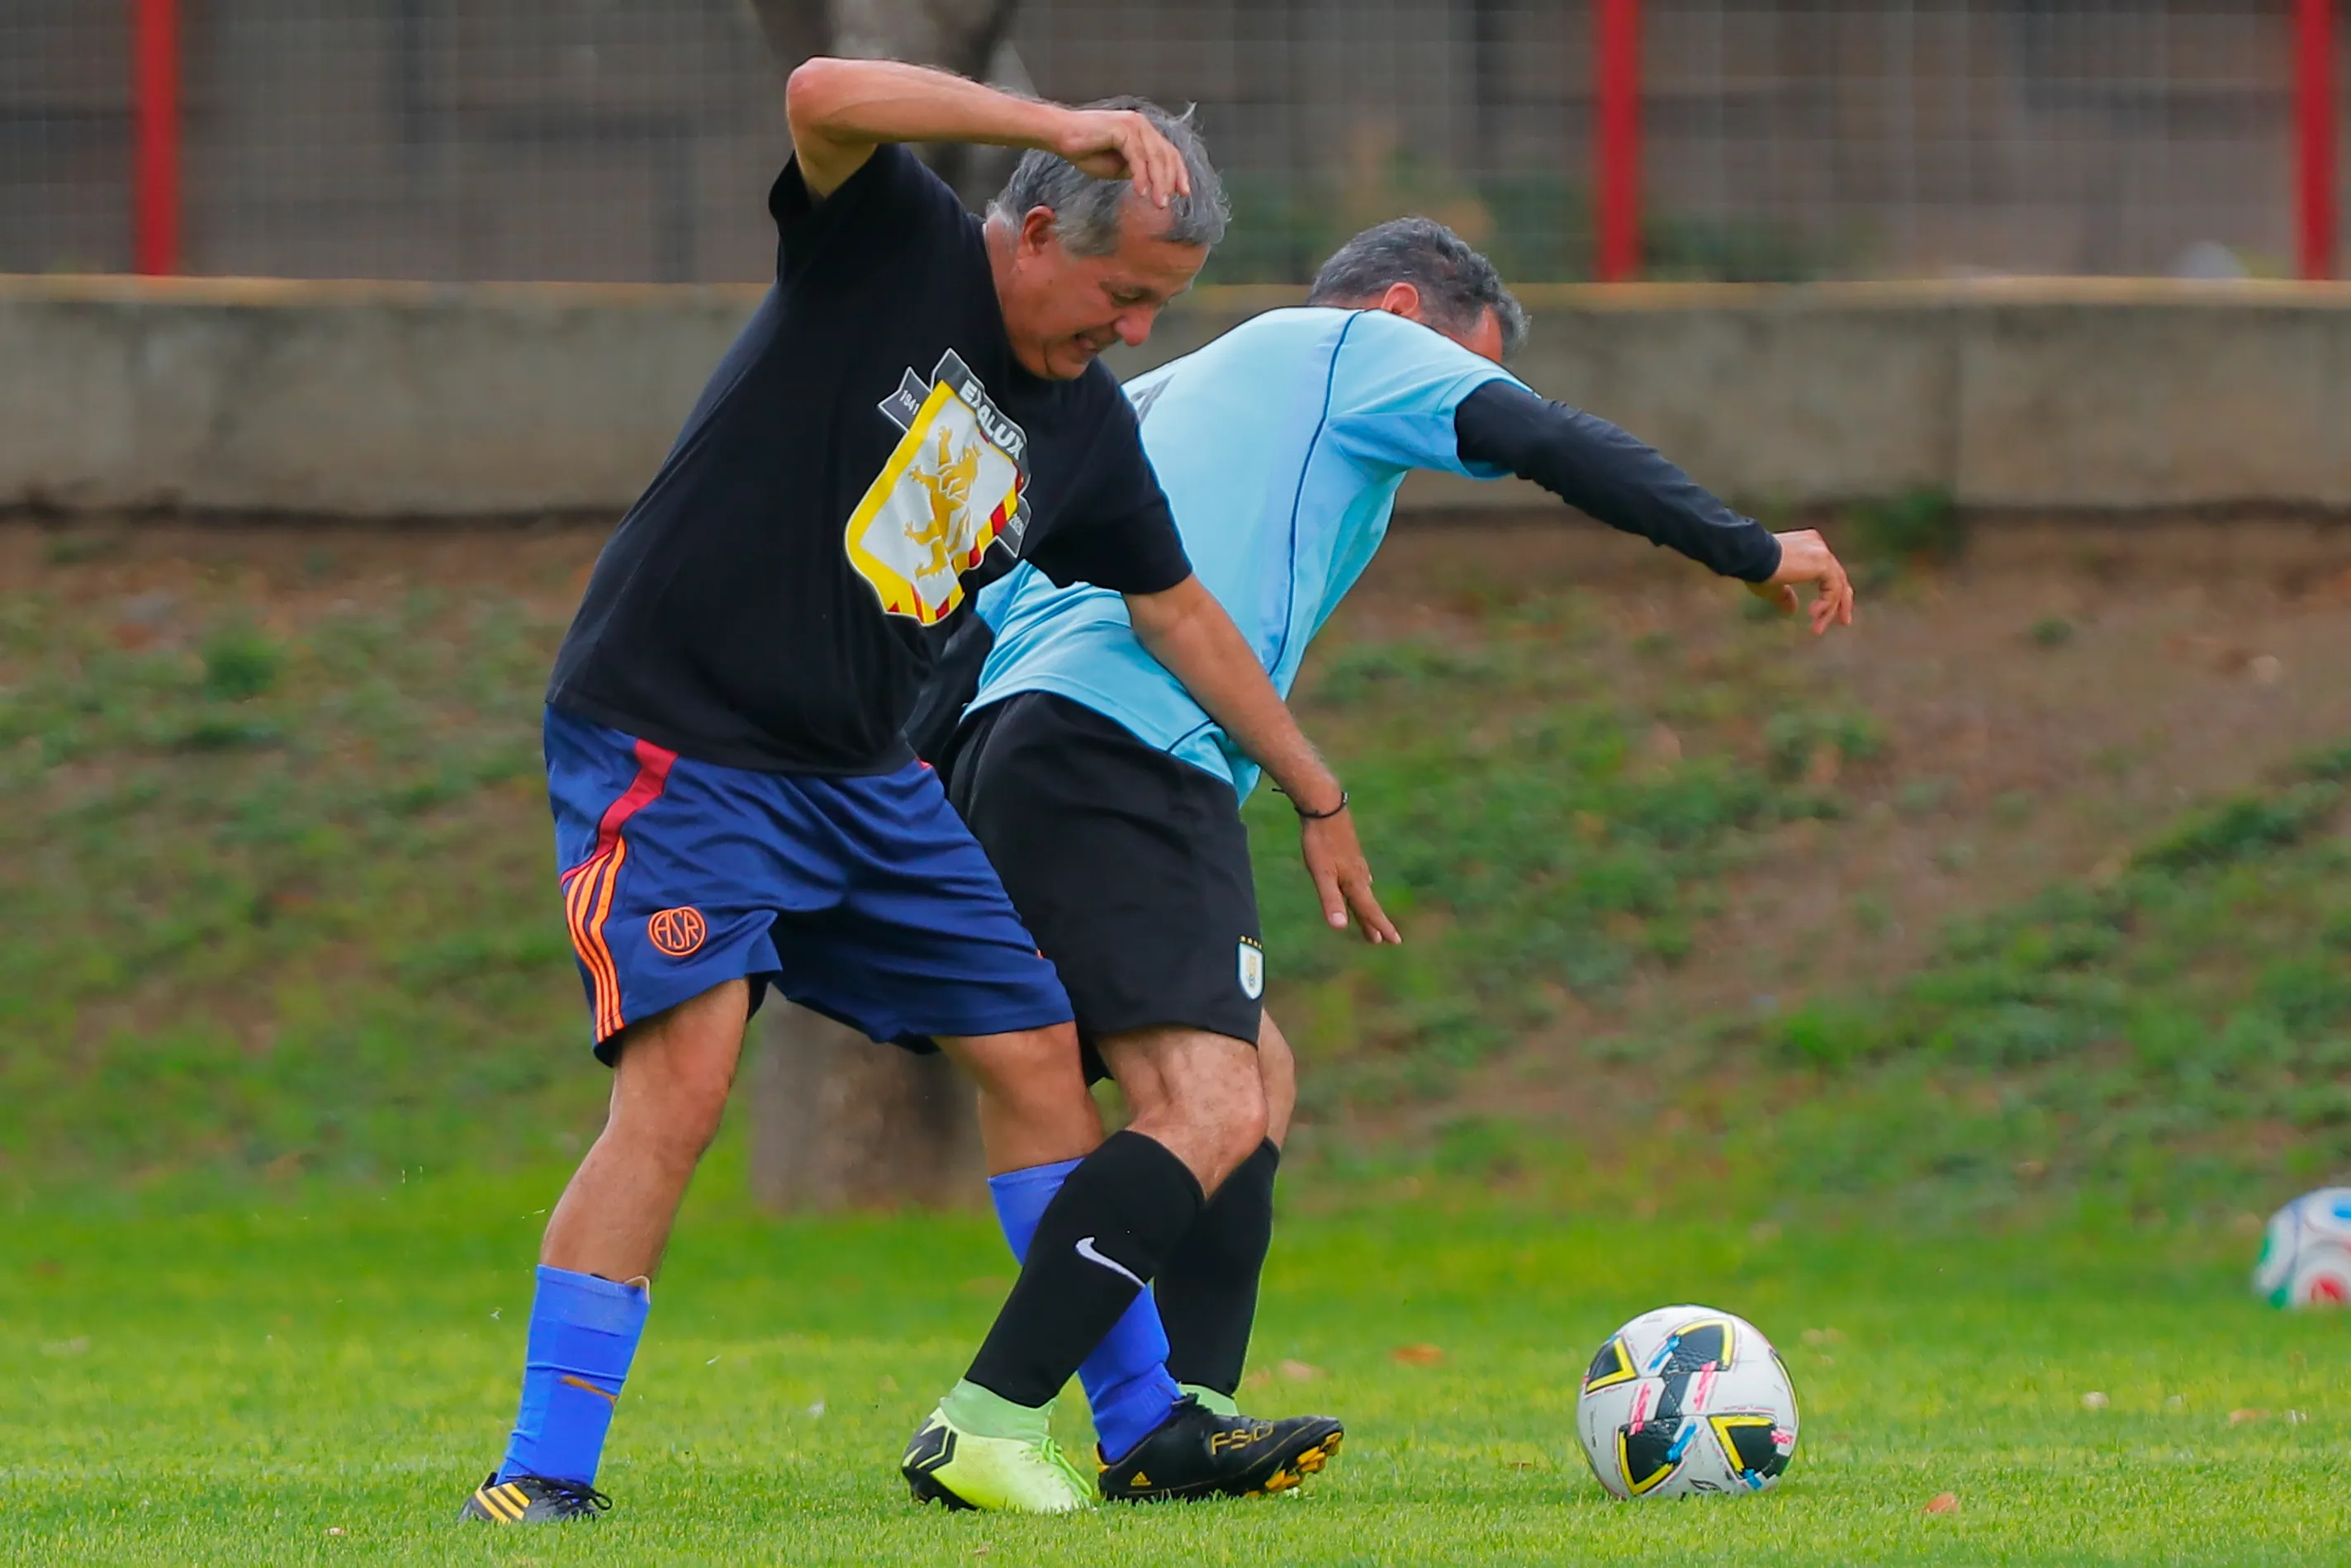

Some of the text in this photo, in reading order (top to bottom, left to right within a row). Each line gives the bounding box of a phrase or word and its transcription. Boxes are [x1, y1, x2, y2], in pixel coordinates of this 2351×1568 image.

[899, 390, 920, 415] 1941
[960, 379, 1024, 460] EXALUX
[654, 910, 699, 950] ASR
